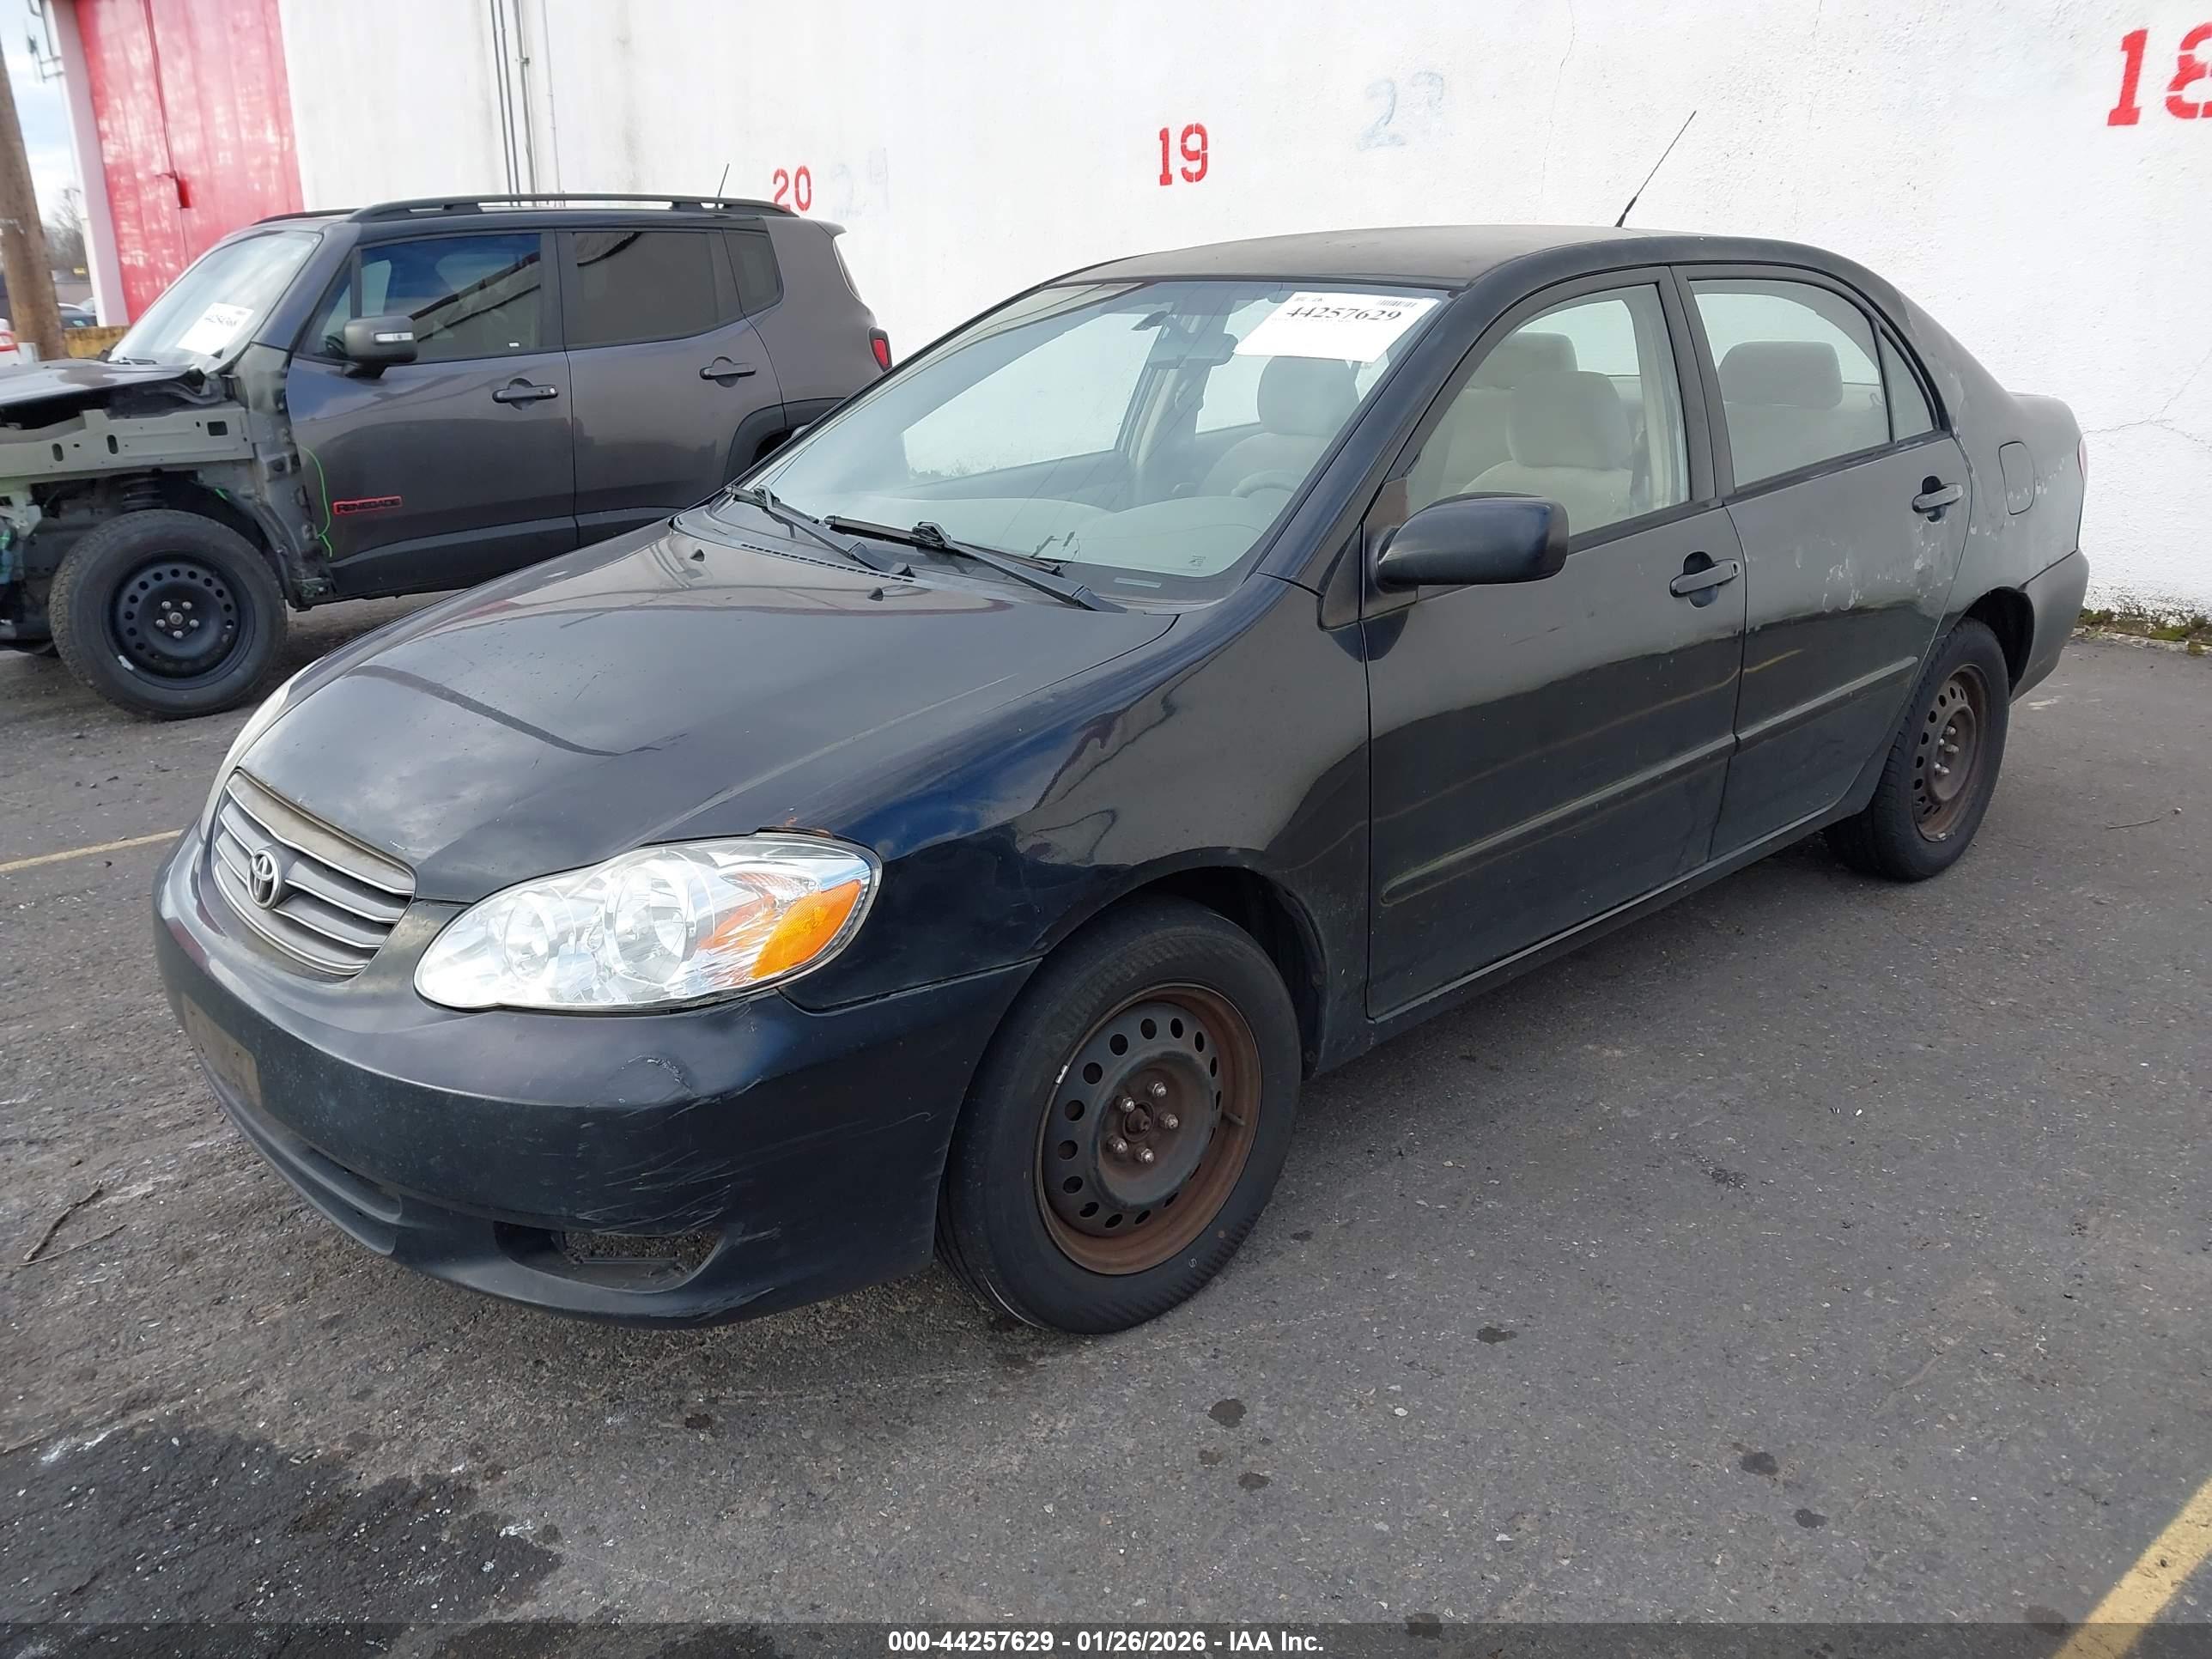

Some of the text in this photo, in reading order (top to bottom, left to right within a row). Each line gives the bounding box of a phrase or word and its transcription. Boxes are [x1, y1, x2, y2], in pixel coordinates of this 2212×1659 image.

[2107, 22, 2212, 126] 18
[1159, 123, 1208, 185] 19
[774, 166, 811, 211] 20
[1286, 306, 1402, 322] 44257629
